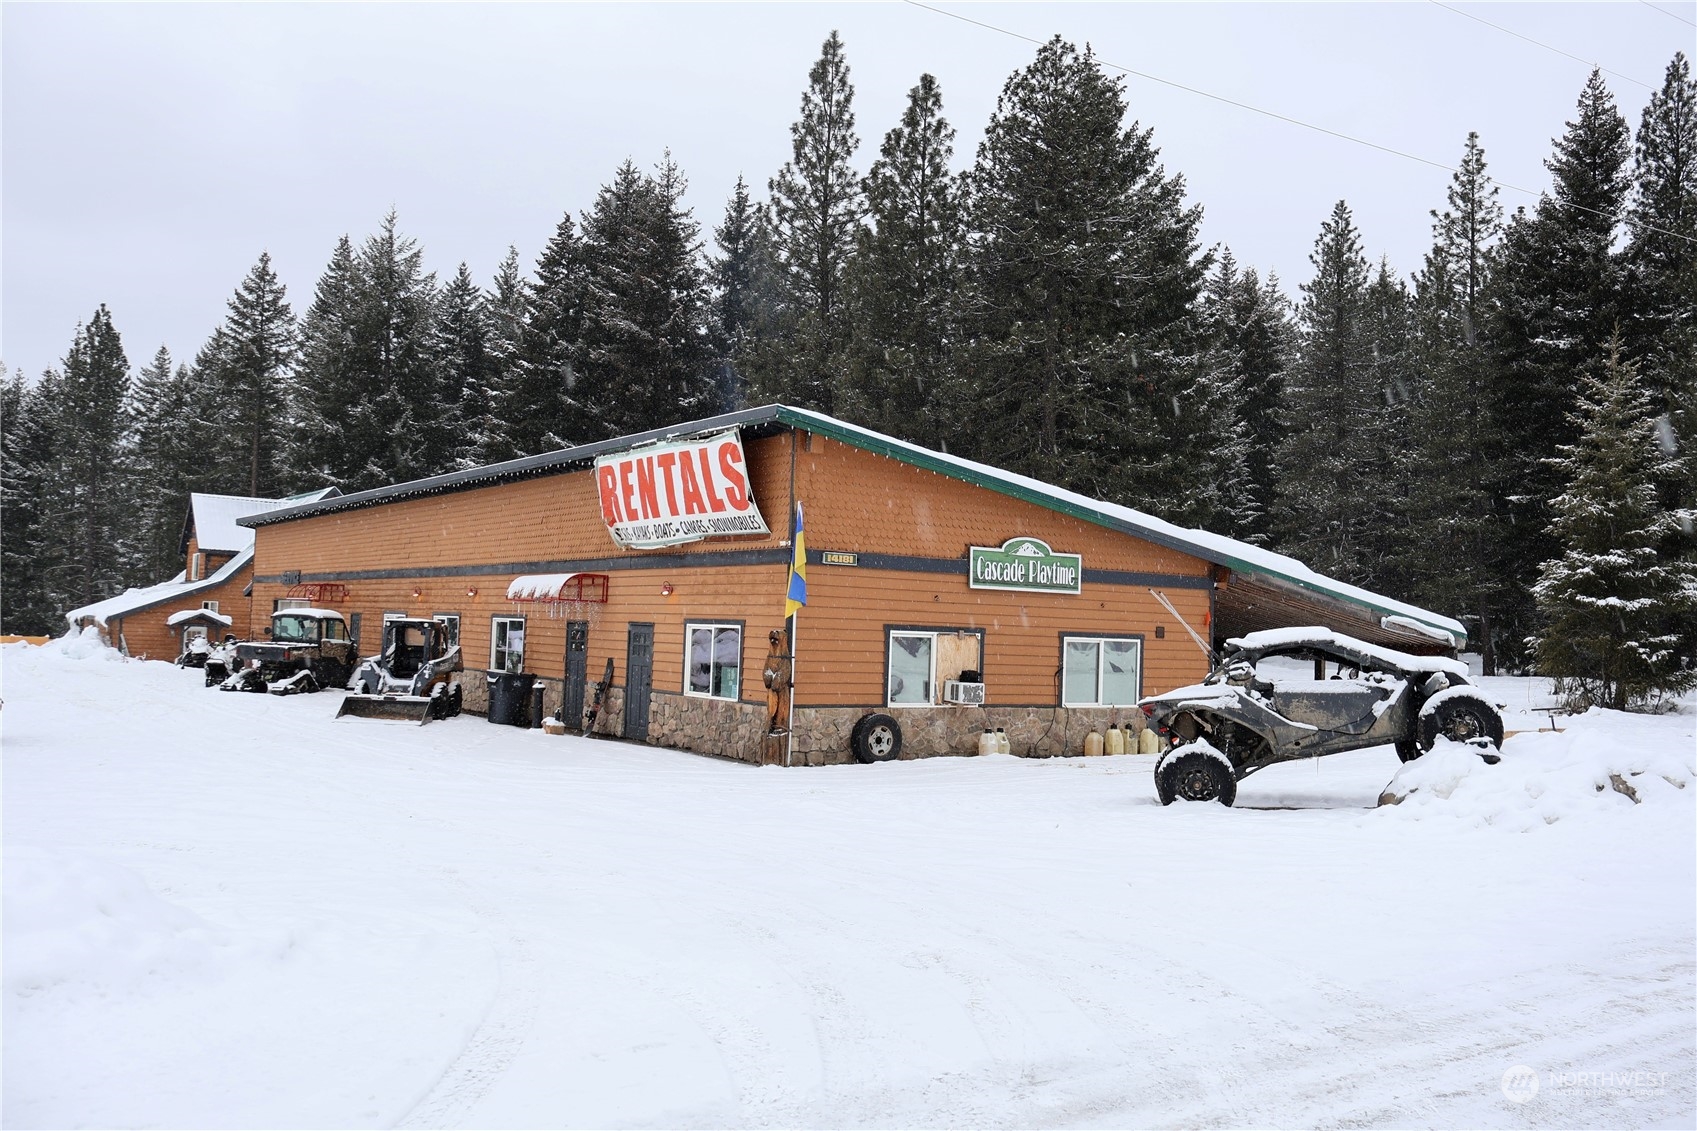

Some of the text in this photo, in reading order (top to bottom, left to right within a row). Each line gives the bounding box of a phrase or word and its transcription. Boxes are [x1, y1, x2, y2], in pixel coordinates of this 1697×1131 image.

[599, 442, 750, 527] RENTALS
[653, 522, 676, 540] BOATS
[709, 515, 762, 533] SNOWMOBILES
[976, 556, 1075, 585] Cascade Playtime
